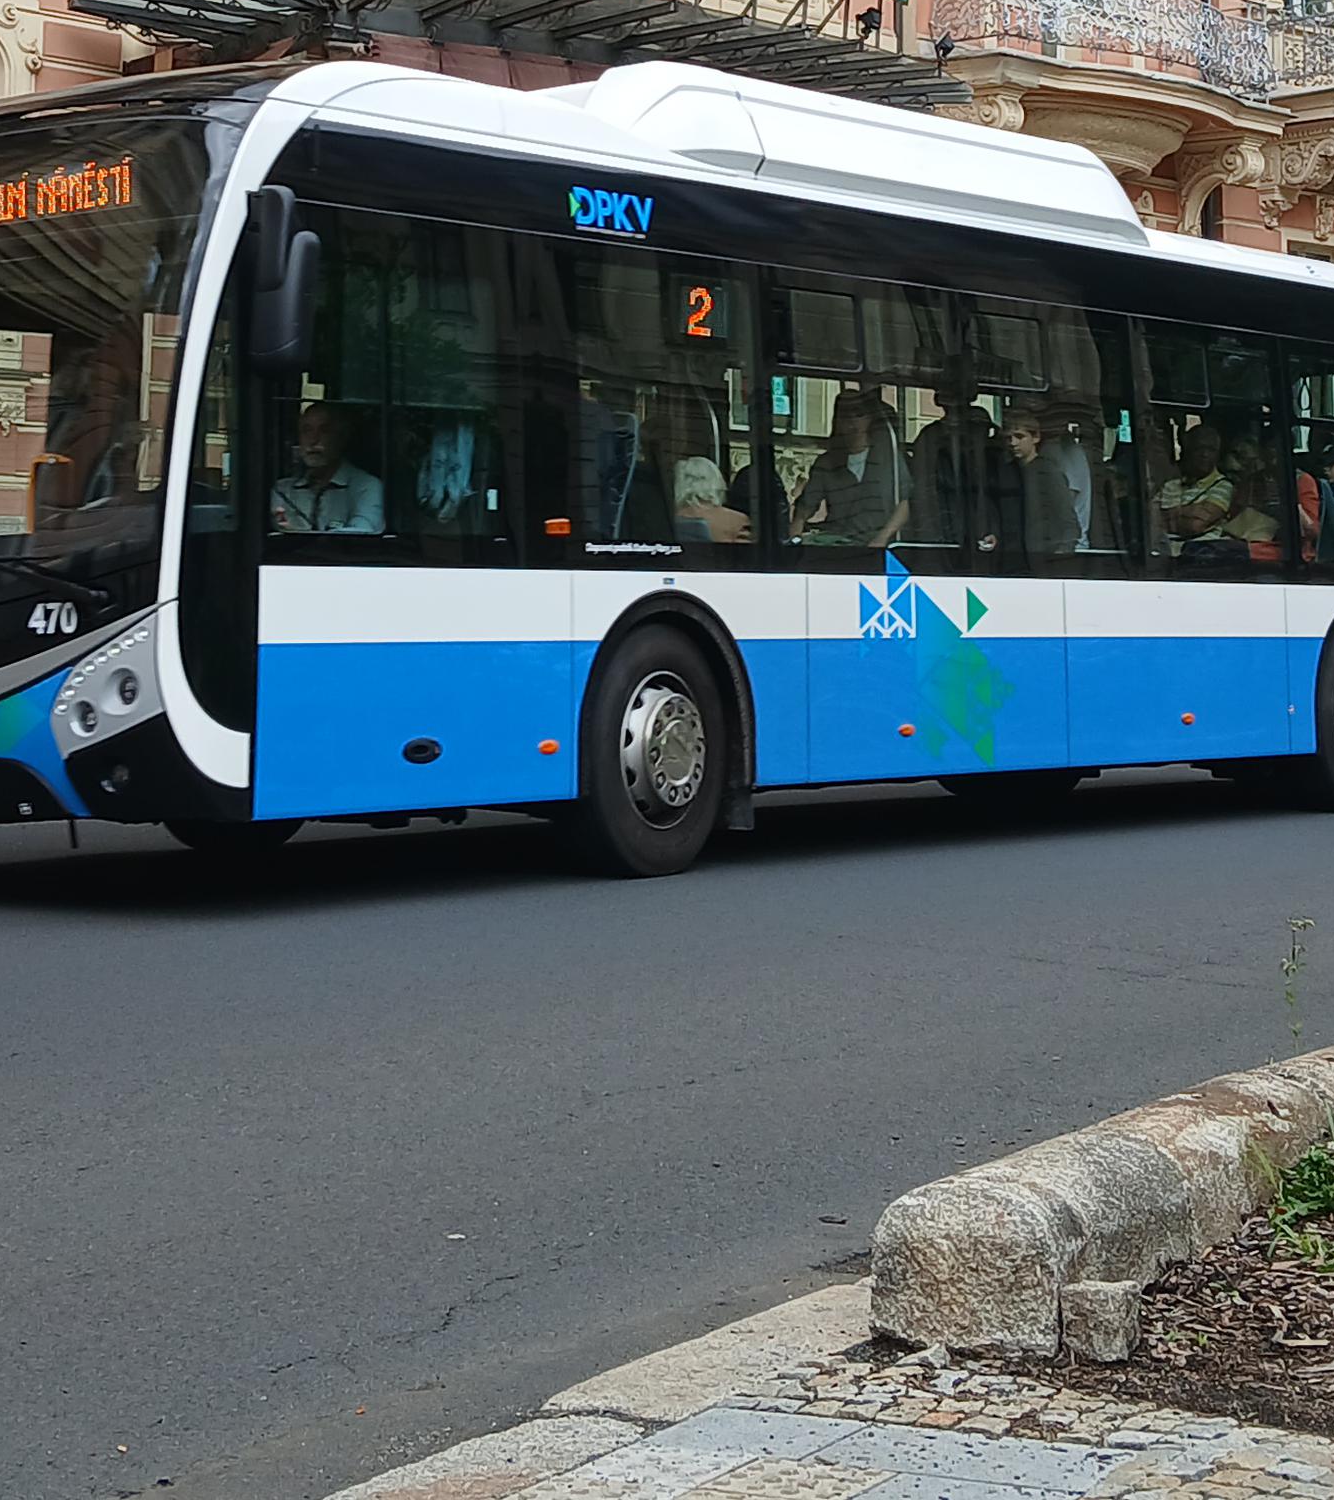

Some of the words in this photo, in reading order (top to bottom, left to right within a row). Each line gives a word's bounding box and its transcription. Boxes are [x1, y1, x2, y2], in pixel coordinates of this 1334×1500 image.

[570, 185, 654, 233] DPKV
[685, 285, 715, 338] 2
[27, 601, 79, 636] 470
